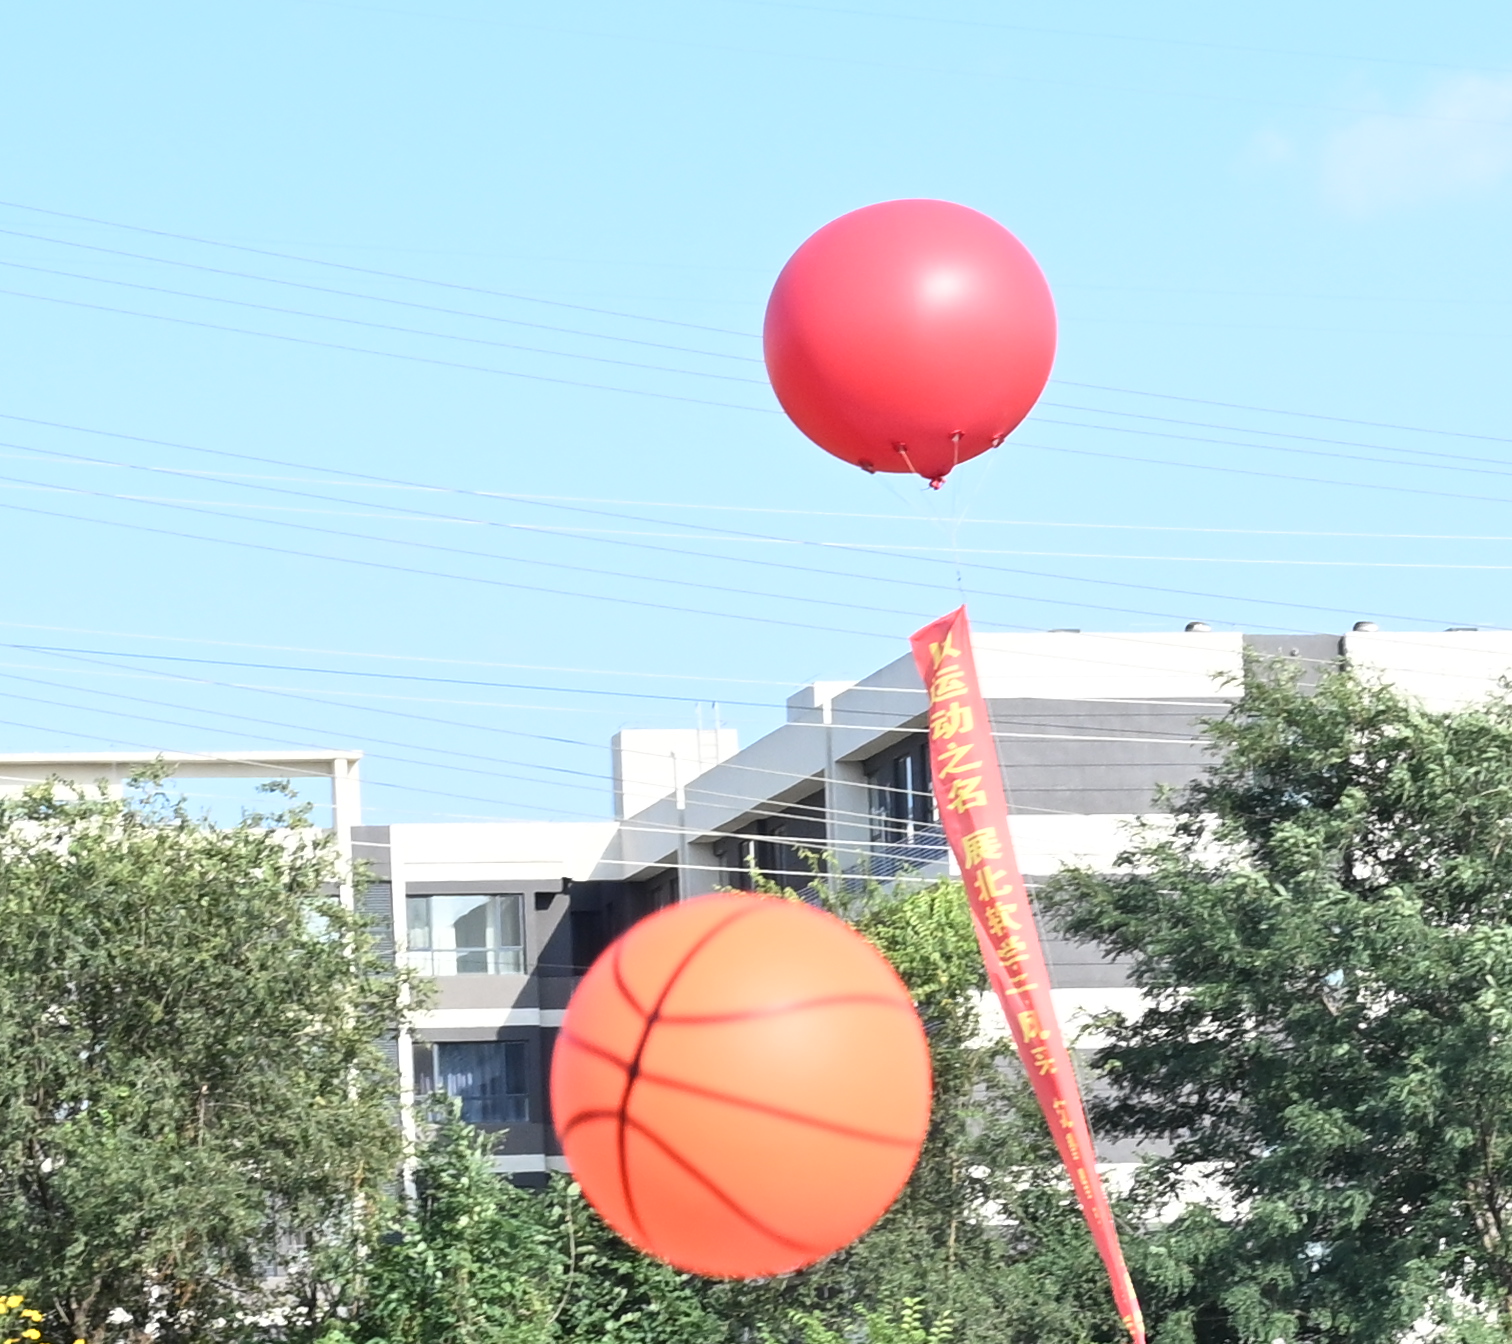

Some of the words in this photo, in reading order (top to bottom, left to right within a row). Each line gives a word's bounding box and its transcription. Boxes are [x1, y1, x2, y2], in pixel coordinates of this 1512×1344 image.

[928, 630, 989, 816] 以运动之名
